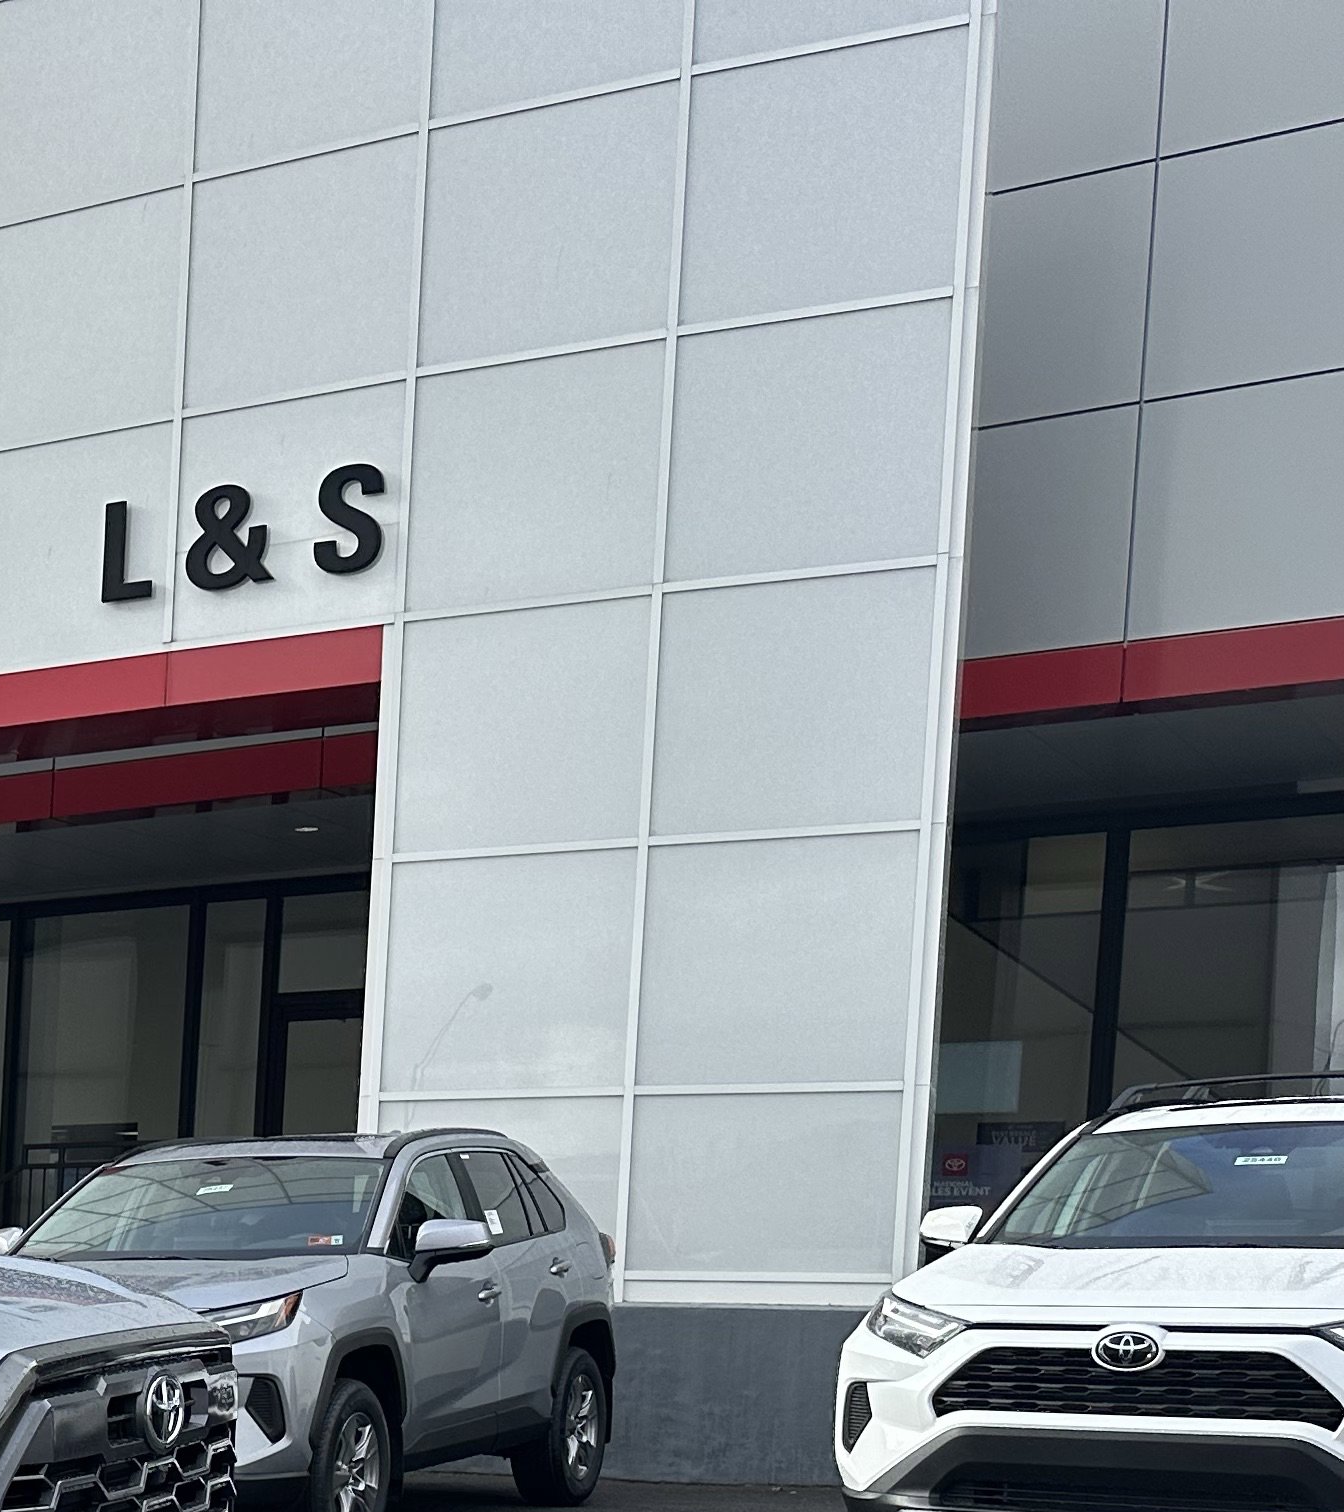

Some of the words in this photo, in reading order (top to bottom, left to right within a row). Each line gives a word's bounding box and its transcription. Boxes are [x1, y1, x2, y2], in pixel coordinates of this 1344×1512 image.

[101, 500, 153, 604] L
[185, 484, 275, 591] &
[313, 463, 385, 574] S
[931, 1187, 951, 1196] LES
[953, 1187, 991, 1196] EVENT
